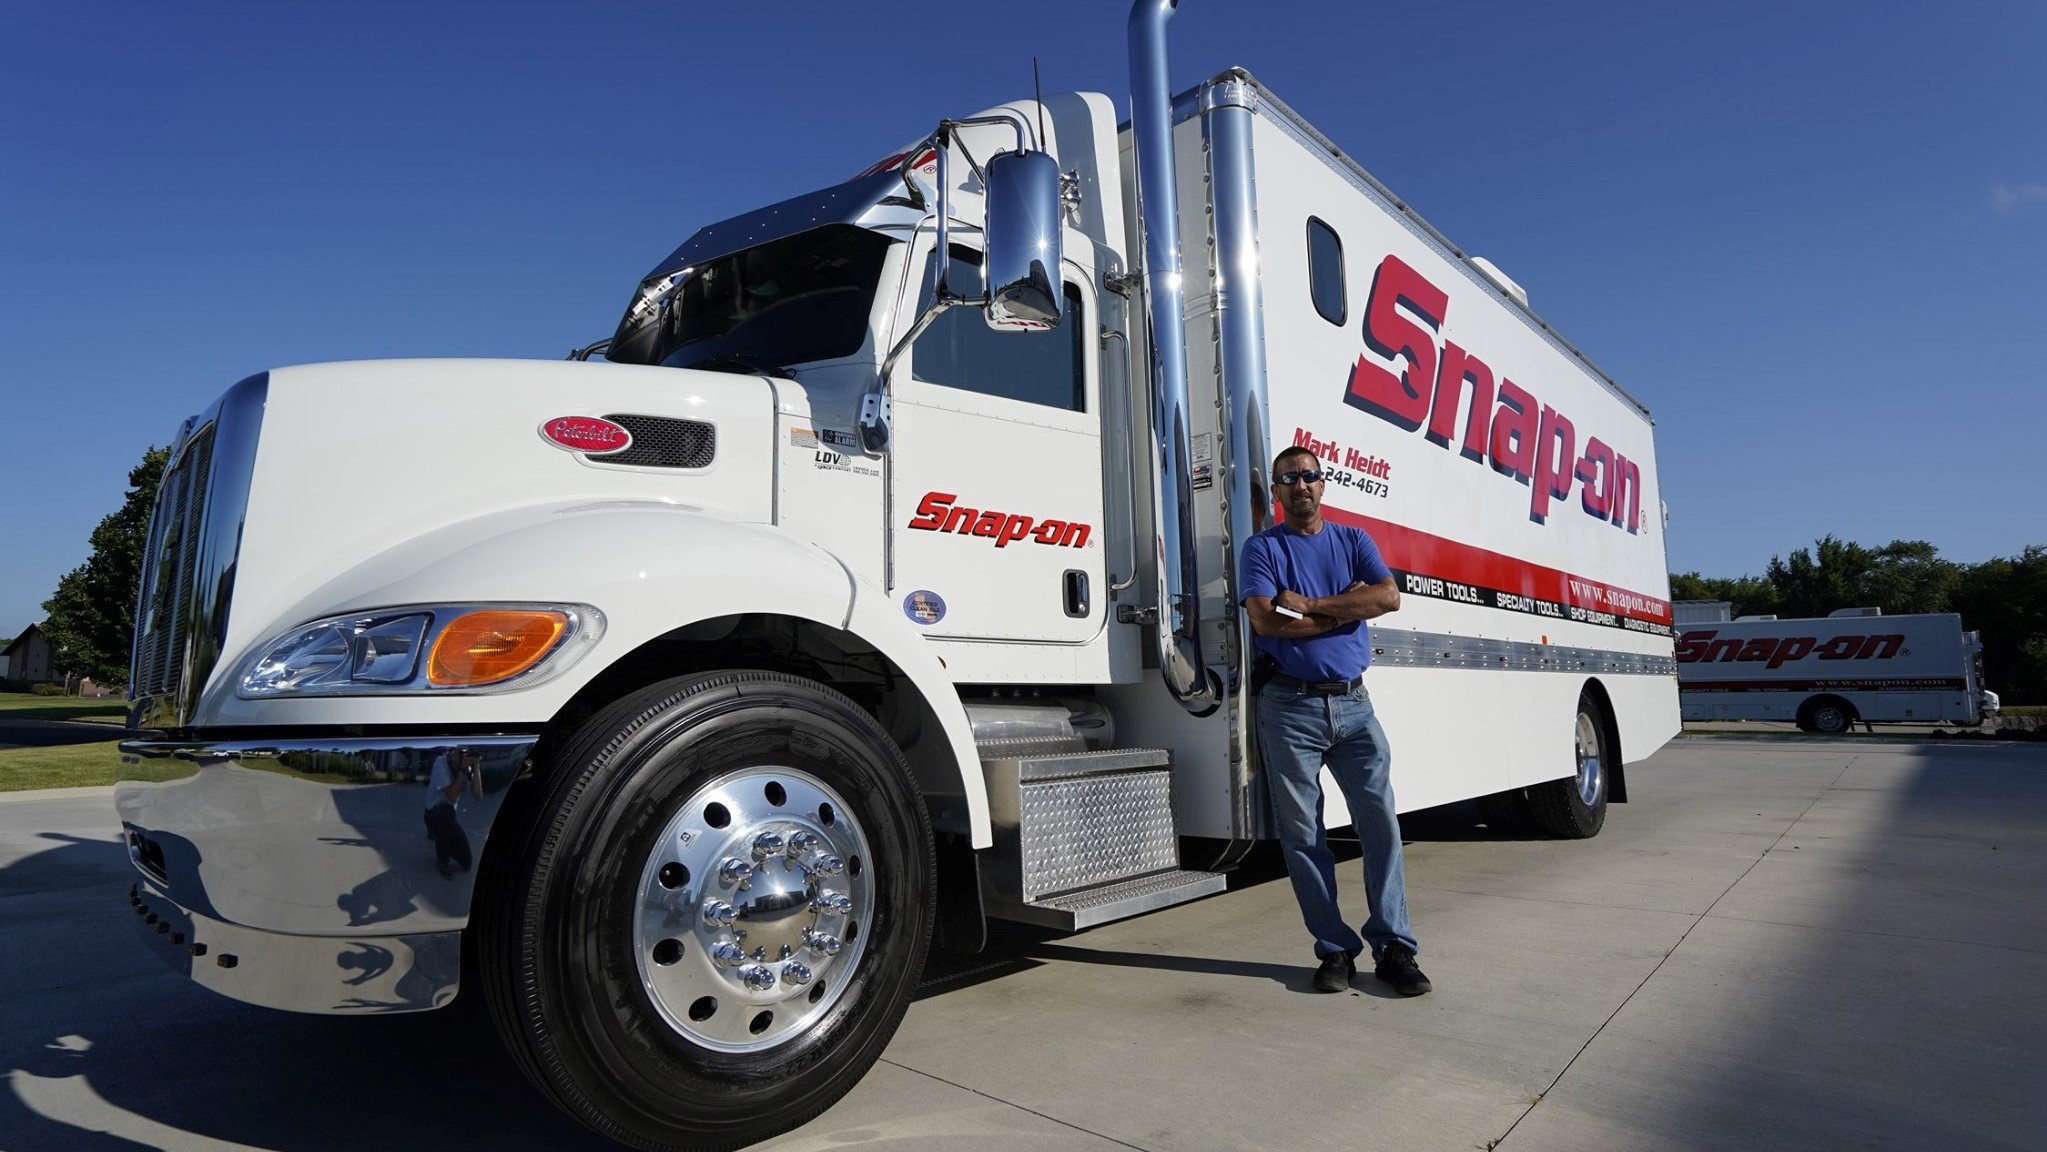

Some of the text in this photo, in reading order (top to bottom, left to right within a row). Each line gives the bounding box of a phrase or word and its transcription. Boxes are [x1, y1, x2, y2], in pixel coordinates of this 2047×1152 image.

[1343, 253, 1641, 536] Snap-on
[553, 420, 625, 442] Peterbilt
[815, 450, 841, 465] LDV
[1292, 427, 1391, 480] Mark Heidt
[1320, 466, 1389, 499] -242-4673
[907, 491, 1092, 548] Snap-on
[1406, 574, 1444, 597] POWER
[1569, 579, 1664, 617] www.snapon.com
[1496, 592, 1535, 613] SPECIALTY
[1570, 607, 1586, 621] SHOP
[1675, 630, 1905, 669] Snap-on
[1815, 679, 1947, 687] www.snapon.com
